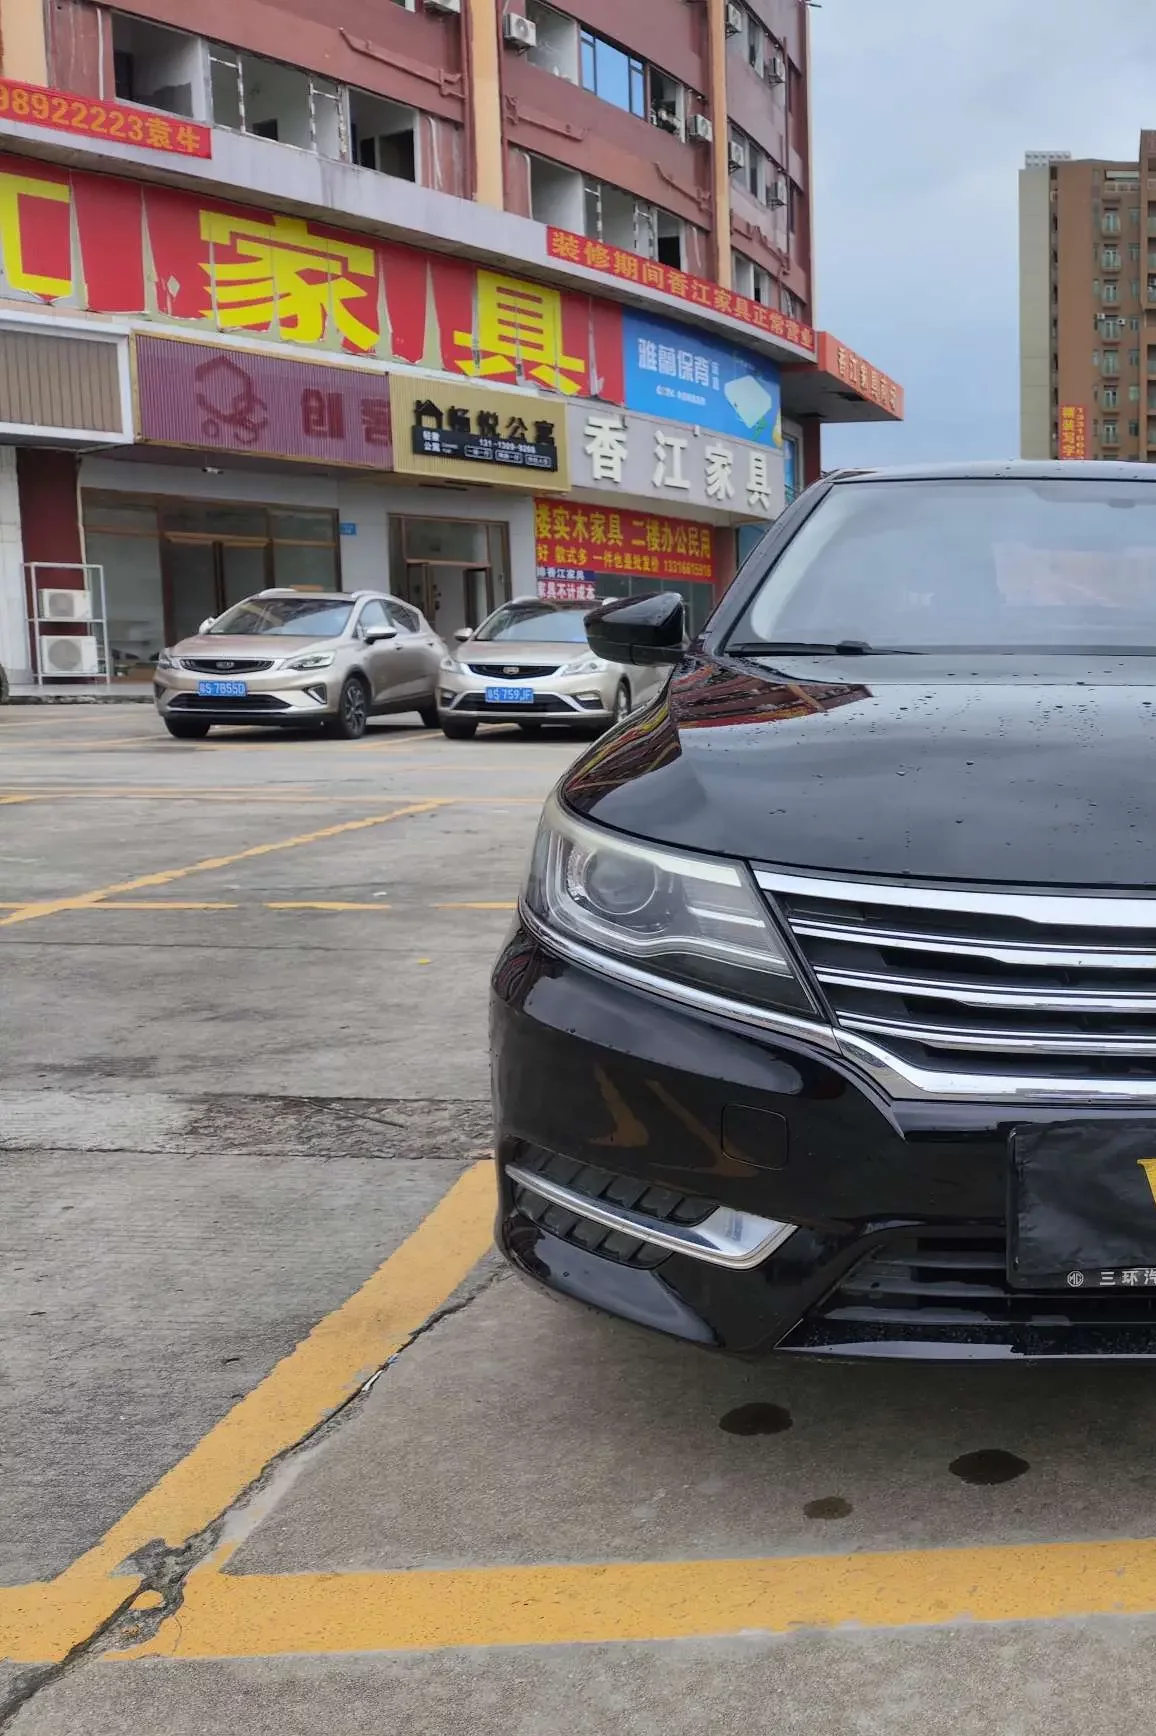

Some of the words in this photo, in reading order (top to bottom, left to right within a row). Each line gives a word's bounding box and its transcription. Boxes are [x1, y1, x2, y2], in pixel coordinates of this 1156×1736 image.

[551, 231, 813, 348] 装修期间香江家具正常营业
[584, 415, 772, 511] 香江家具
